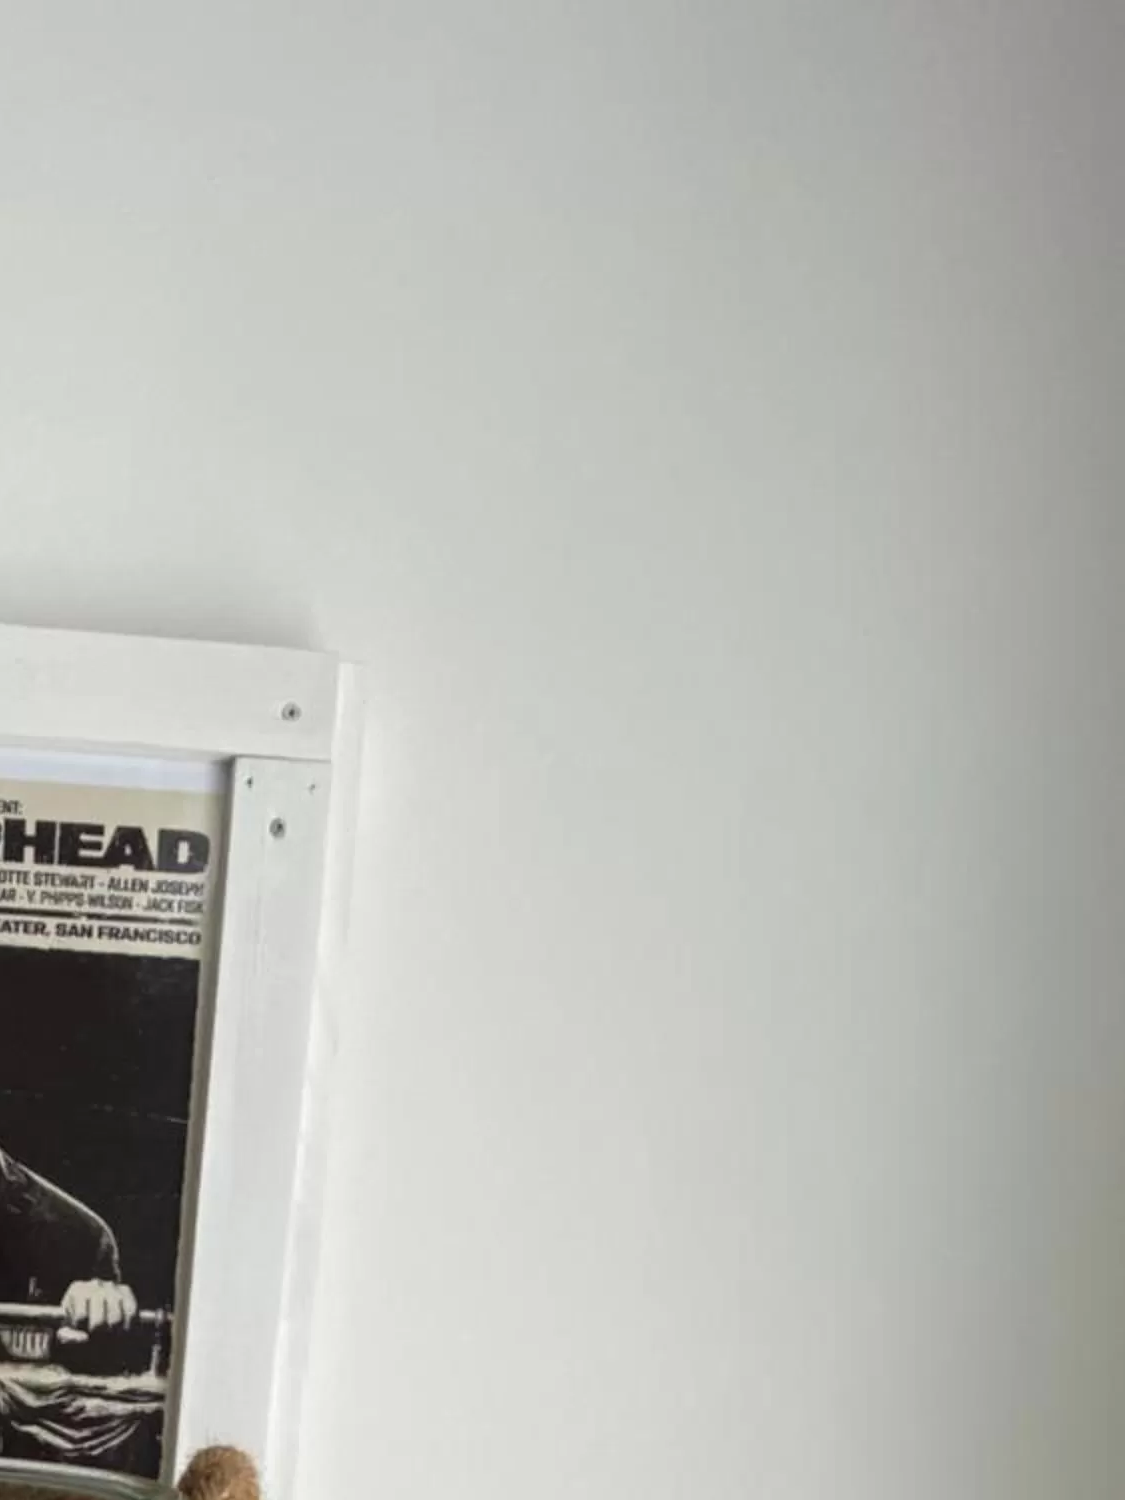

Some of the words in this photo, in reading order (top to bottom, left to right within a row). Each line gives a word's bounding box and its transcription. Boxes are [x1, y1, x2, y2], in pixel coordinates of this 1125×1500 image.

[33, 871, 95, 889] STEWART
[107, 876, 149, 893] ALLEN
[55, 922, 94, 939] SAN
[97, 926, 202, 946] FRANCISCO
